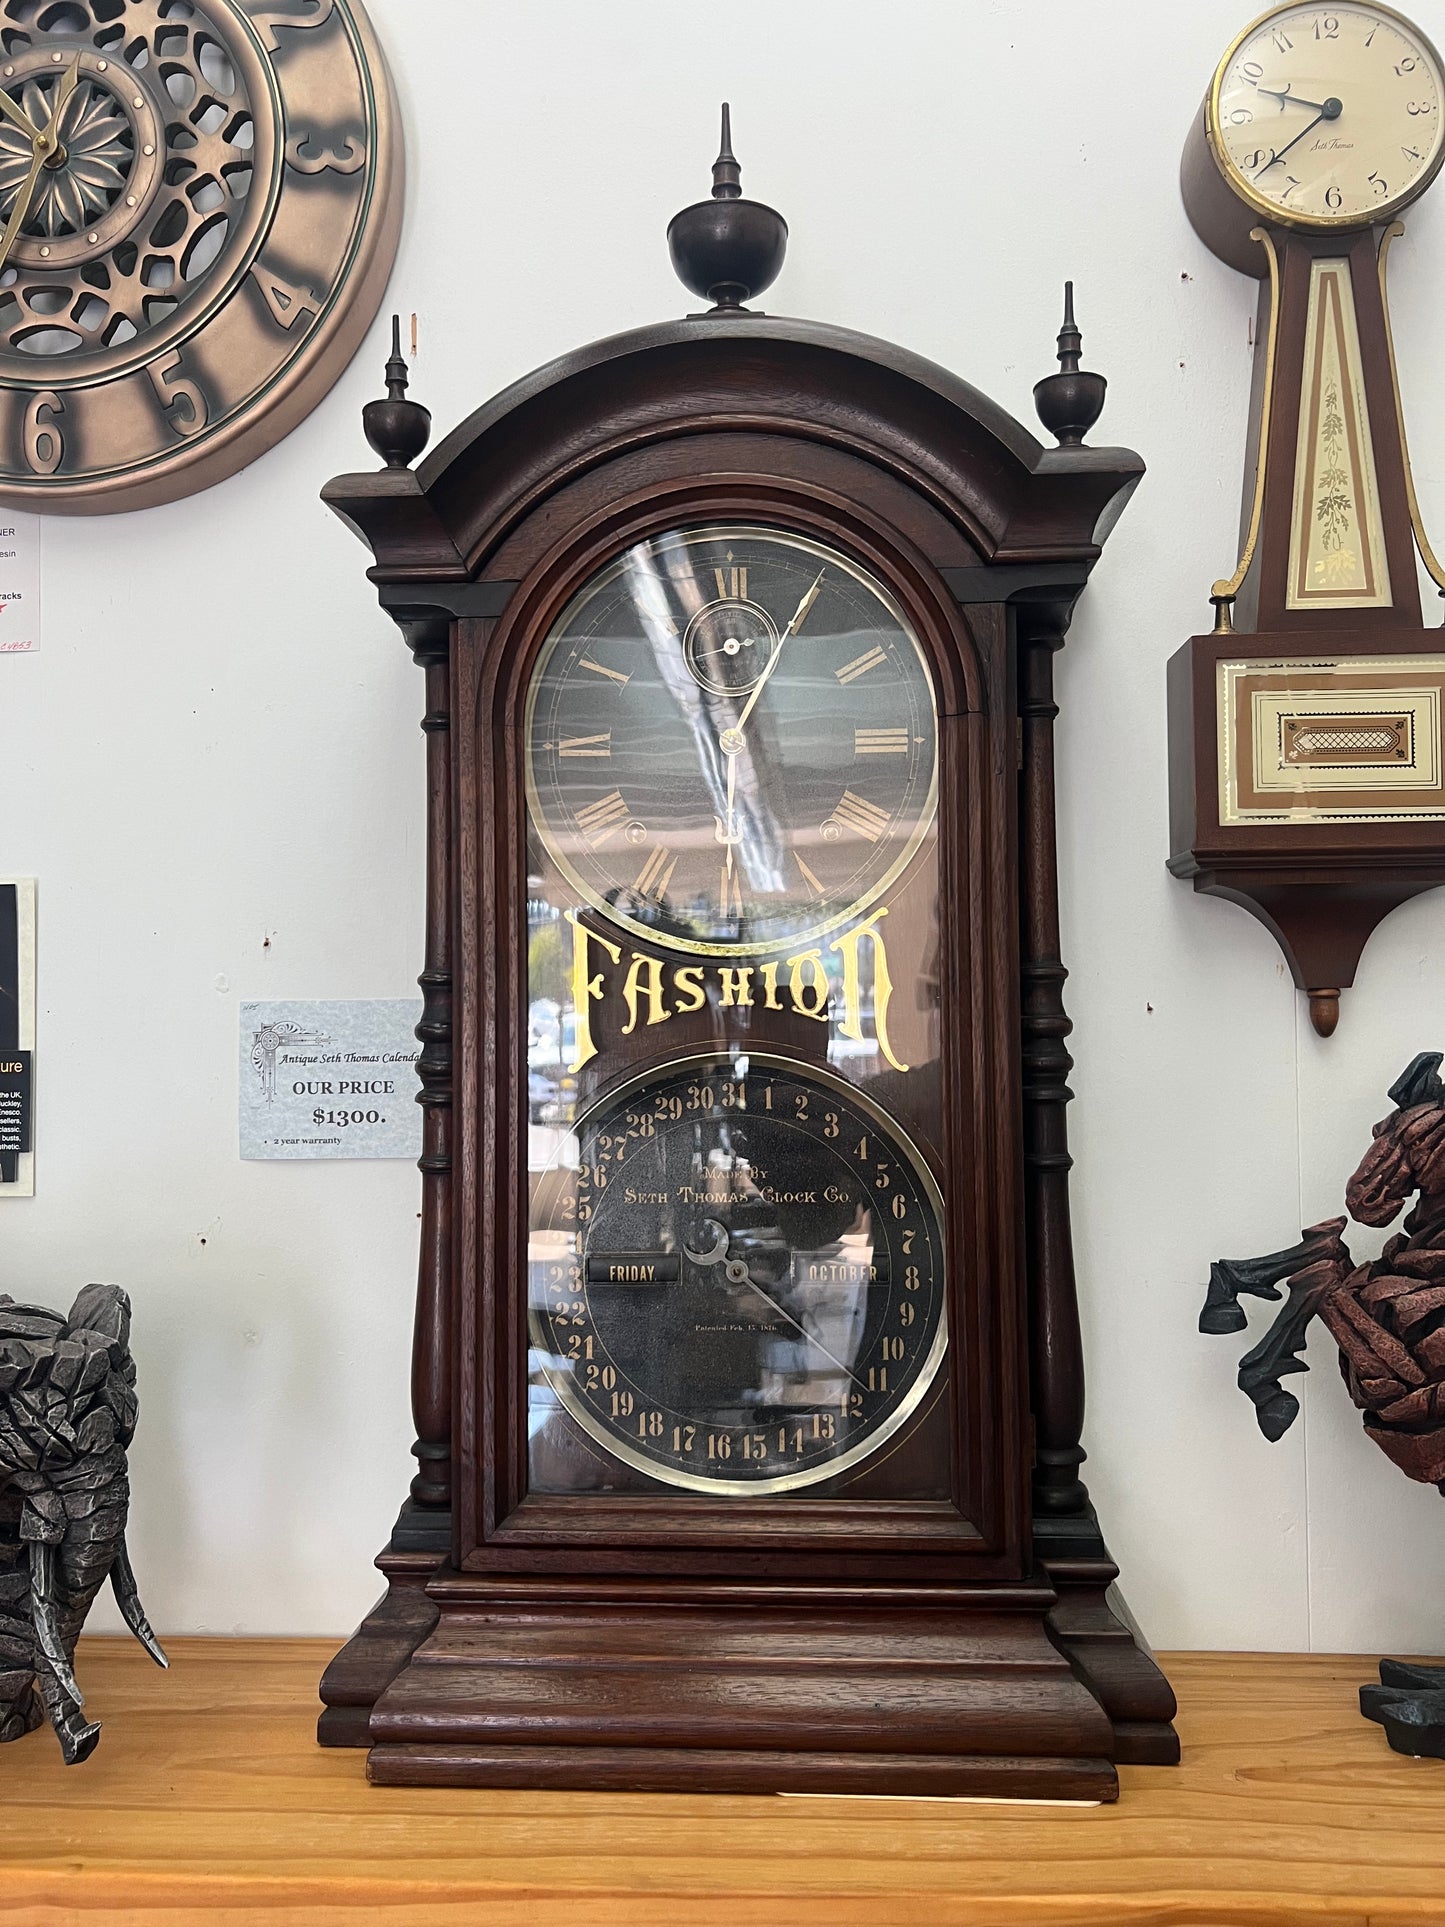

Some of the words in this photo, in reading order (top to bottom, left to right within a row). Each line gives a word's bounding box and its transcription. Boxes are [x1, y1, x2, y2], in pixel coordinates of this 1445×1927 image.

[1311, 17, 1340, 40] 12
[1364, 28, 1377, 47] 1
[1272, 31, 1294, 54] 11
[1239, 61, 1264, 87] 10
[1393, 57, 1416, 77] 2
[1230, 108, 1254, 125] 9
[1406, 101, 1431, 116] 3
[285, 133, 366, 175] 3
[1243, 149, 1266, 169] 8
[1400, 146, 1421, 163] 4
[1281, 175, 1301, 199] 7
[1367, 171, 1388, 195] 5
[1325, 186, 1343, 208] 6
[250, 261, 318, 331] 4
[146, 351, 209, 436] 5
[24, 391, 65, 474] 6
[834, 645, 888, 686] II
[854, 727, 908, 754] III
[564, 907, 910, 1074] FASHION
[0, 1062, 23, 1073] ure
[279, 1053, 318, 1066] Antique
[319, 1052, 342, 1064] Seth
[343, 1052, 380, 1063] Thomas
[382, 1052, 421, 1063] Calenda
[292, 1081, 334, 1095] OUR
[338, 1080, 395, 1094] PRICE
[686, 1086, 714, 1110] 30
[722, 1082, 746, 1110] 31
[763, 1086, 773, 1110] 1
[312, 1107, 386, 1127] $1300.
[654, 1096, 683, 1120] 29
[795, 1095, 809, 1121] 2
[626, 1113, 655, 1138] 28
[824, 1112, 840, 1138] 3
[280, 1138, 300, 1146] year
[302, 1137, 342, 1146] warranty
[600, 1136, 628, 1161] 27
[853, 1136, 868, 1160] 4
[576, 1164, 607, 1189] 26
[875, 1163, 890, 1189] 5
[561, 1196, 592, 1221] 25
[892, 1194, 906, 1220] 6
[902, 1229, 916, 1255] 7
[550, 1265, 583, 1293] 23
[609, 1265, 655, 1281] FRIDAY
[809, 1264, 877, 1281] OCTOBER
[905, 1265, 920, 1291] 8
[555, 1301, 586, 1326] 22
[900, 1302, 915, 1327] 9
[568, 1335, 594, 1360] 21
[882, 1336, 905, 1361] 10
[586, 1364, 616, 1390] 20
[868, 1367, 887, 1392] 11
[609, 1391, 634, 1417] 19
[840, 1392, 863, 1418] 12
[637, 1411, 664, 1437] 18
[812, 1413, 835, 1439] 13
[672, 1425, 696, 1452] 17
[708, 1434, 731, 1459] 16
[743, 1434, 767, 1459] 15
[778, 1427, 803, 1453] 14
